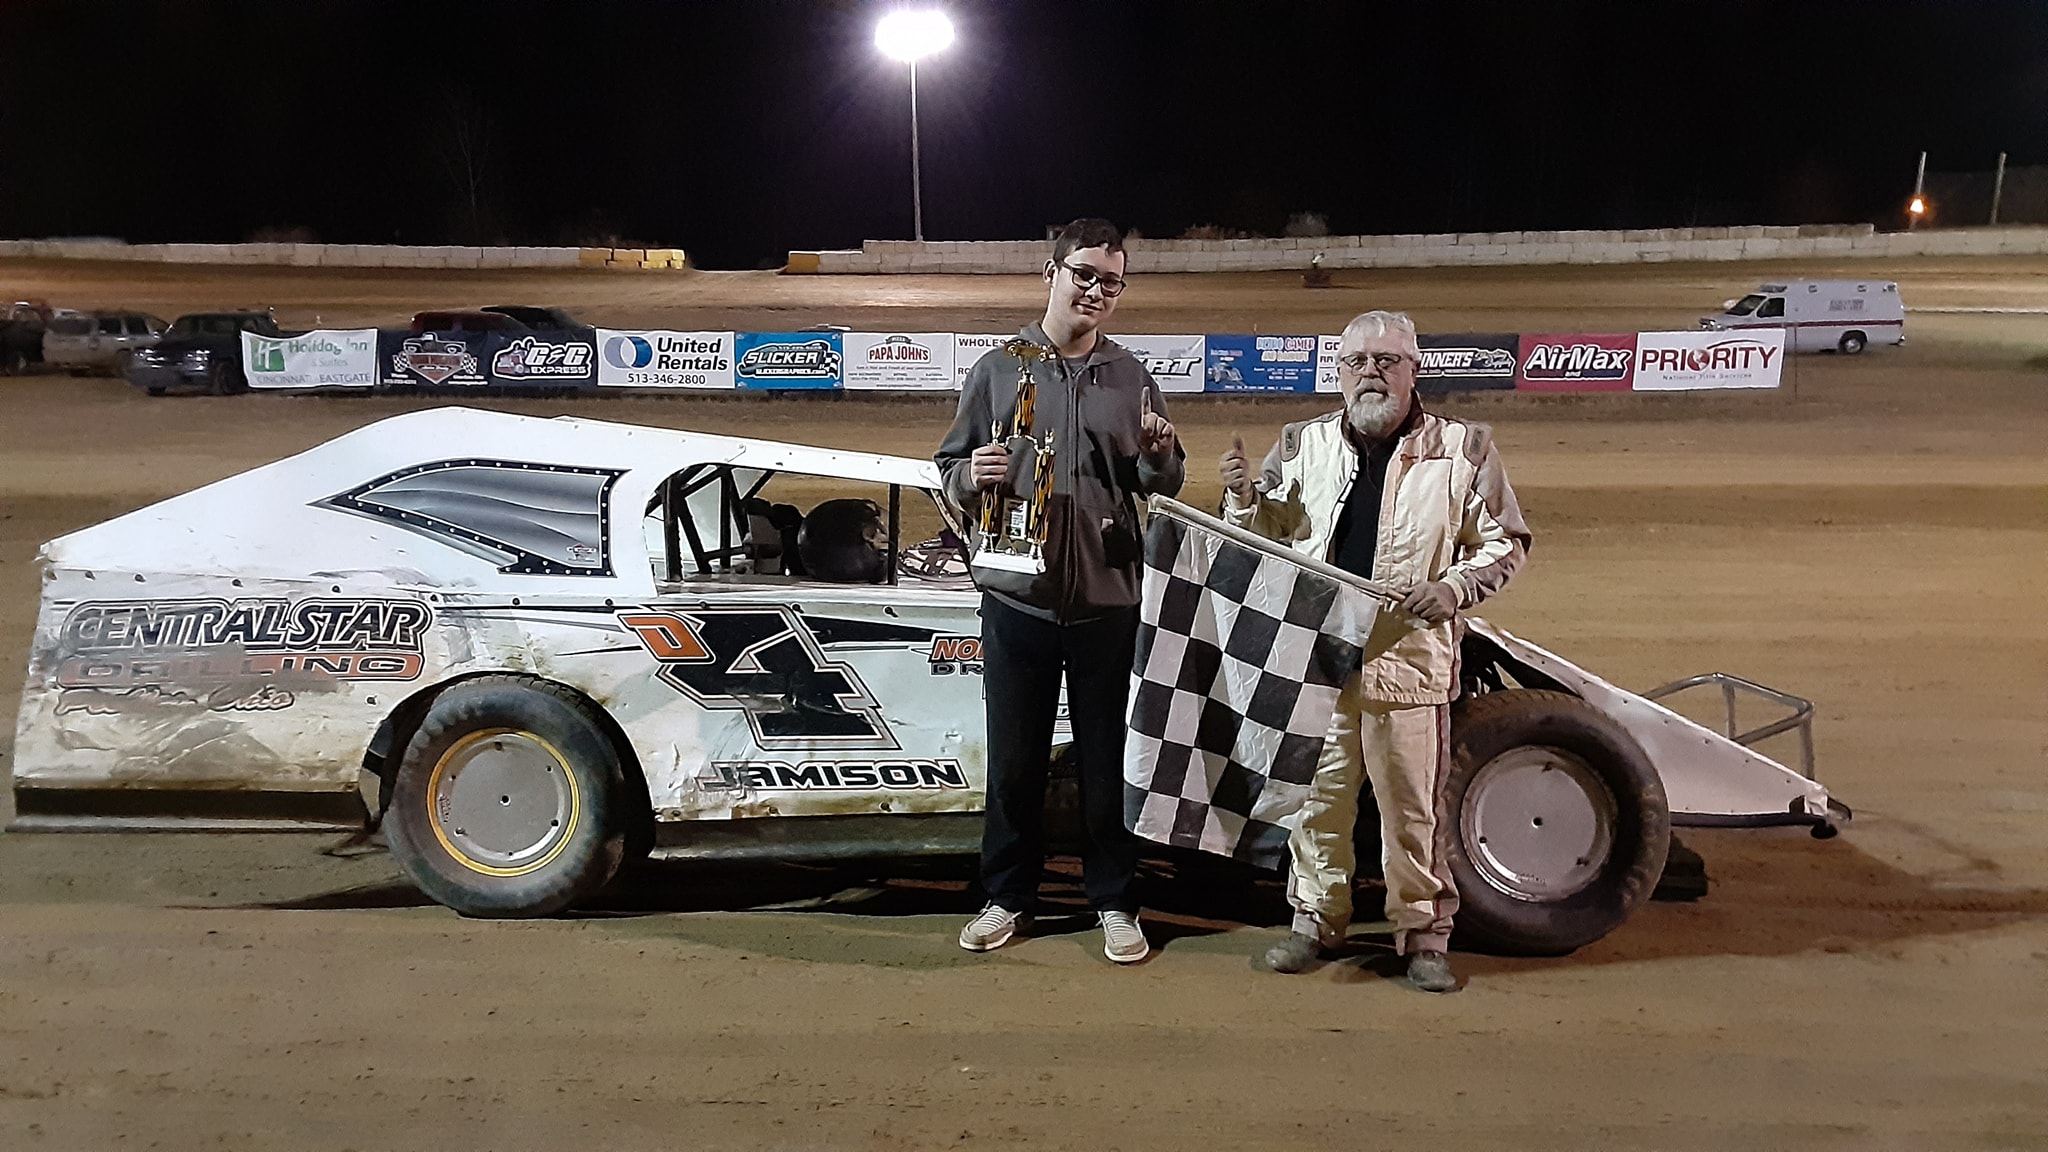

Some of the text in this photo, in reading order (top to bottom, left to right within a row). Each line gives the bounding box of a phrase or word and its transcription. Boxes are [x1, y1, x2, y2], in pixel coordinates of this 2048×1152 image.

[657, 337, 722, 354] United
[869, 346, 929, 361] PAPA JOHN'S
[525, 347, 588, 365] G&G
[657, 354, 728, 371] Rentals
[745, 351, 818, 364] SLICKER
[1419, 352, 1474, 368] INNER'S
[1526, 347, 1629, 370] AirMax
[1641, 346, 1778, 372] PRIORITY
[531, 366, 586, 374] EXPRESS
[256, 373, 370, 384] CINCINNAT EASTGATE
[627, 373, 706, 385] 513-346-2800
[697, 760, 969, 789] JAMISON
